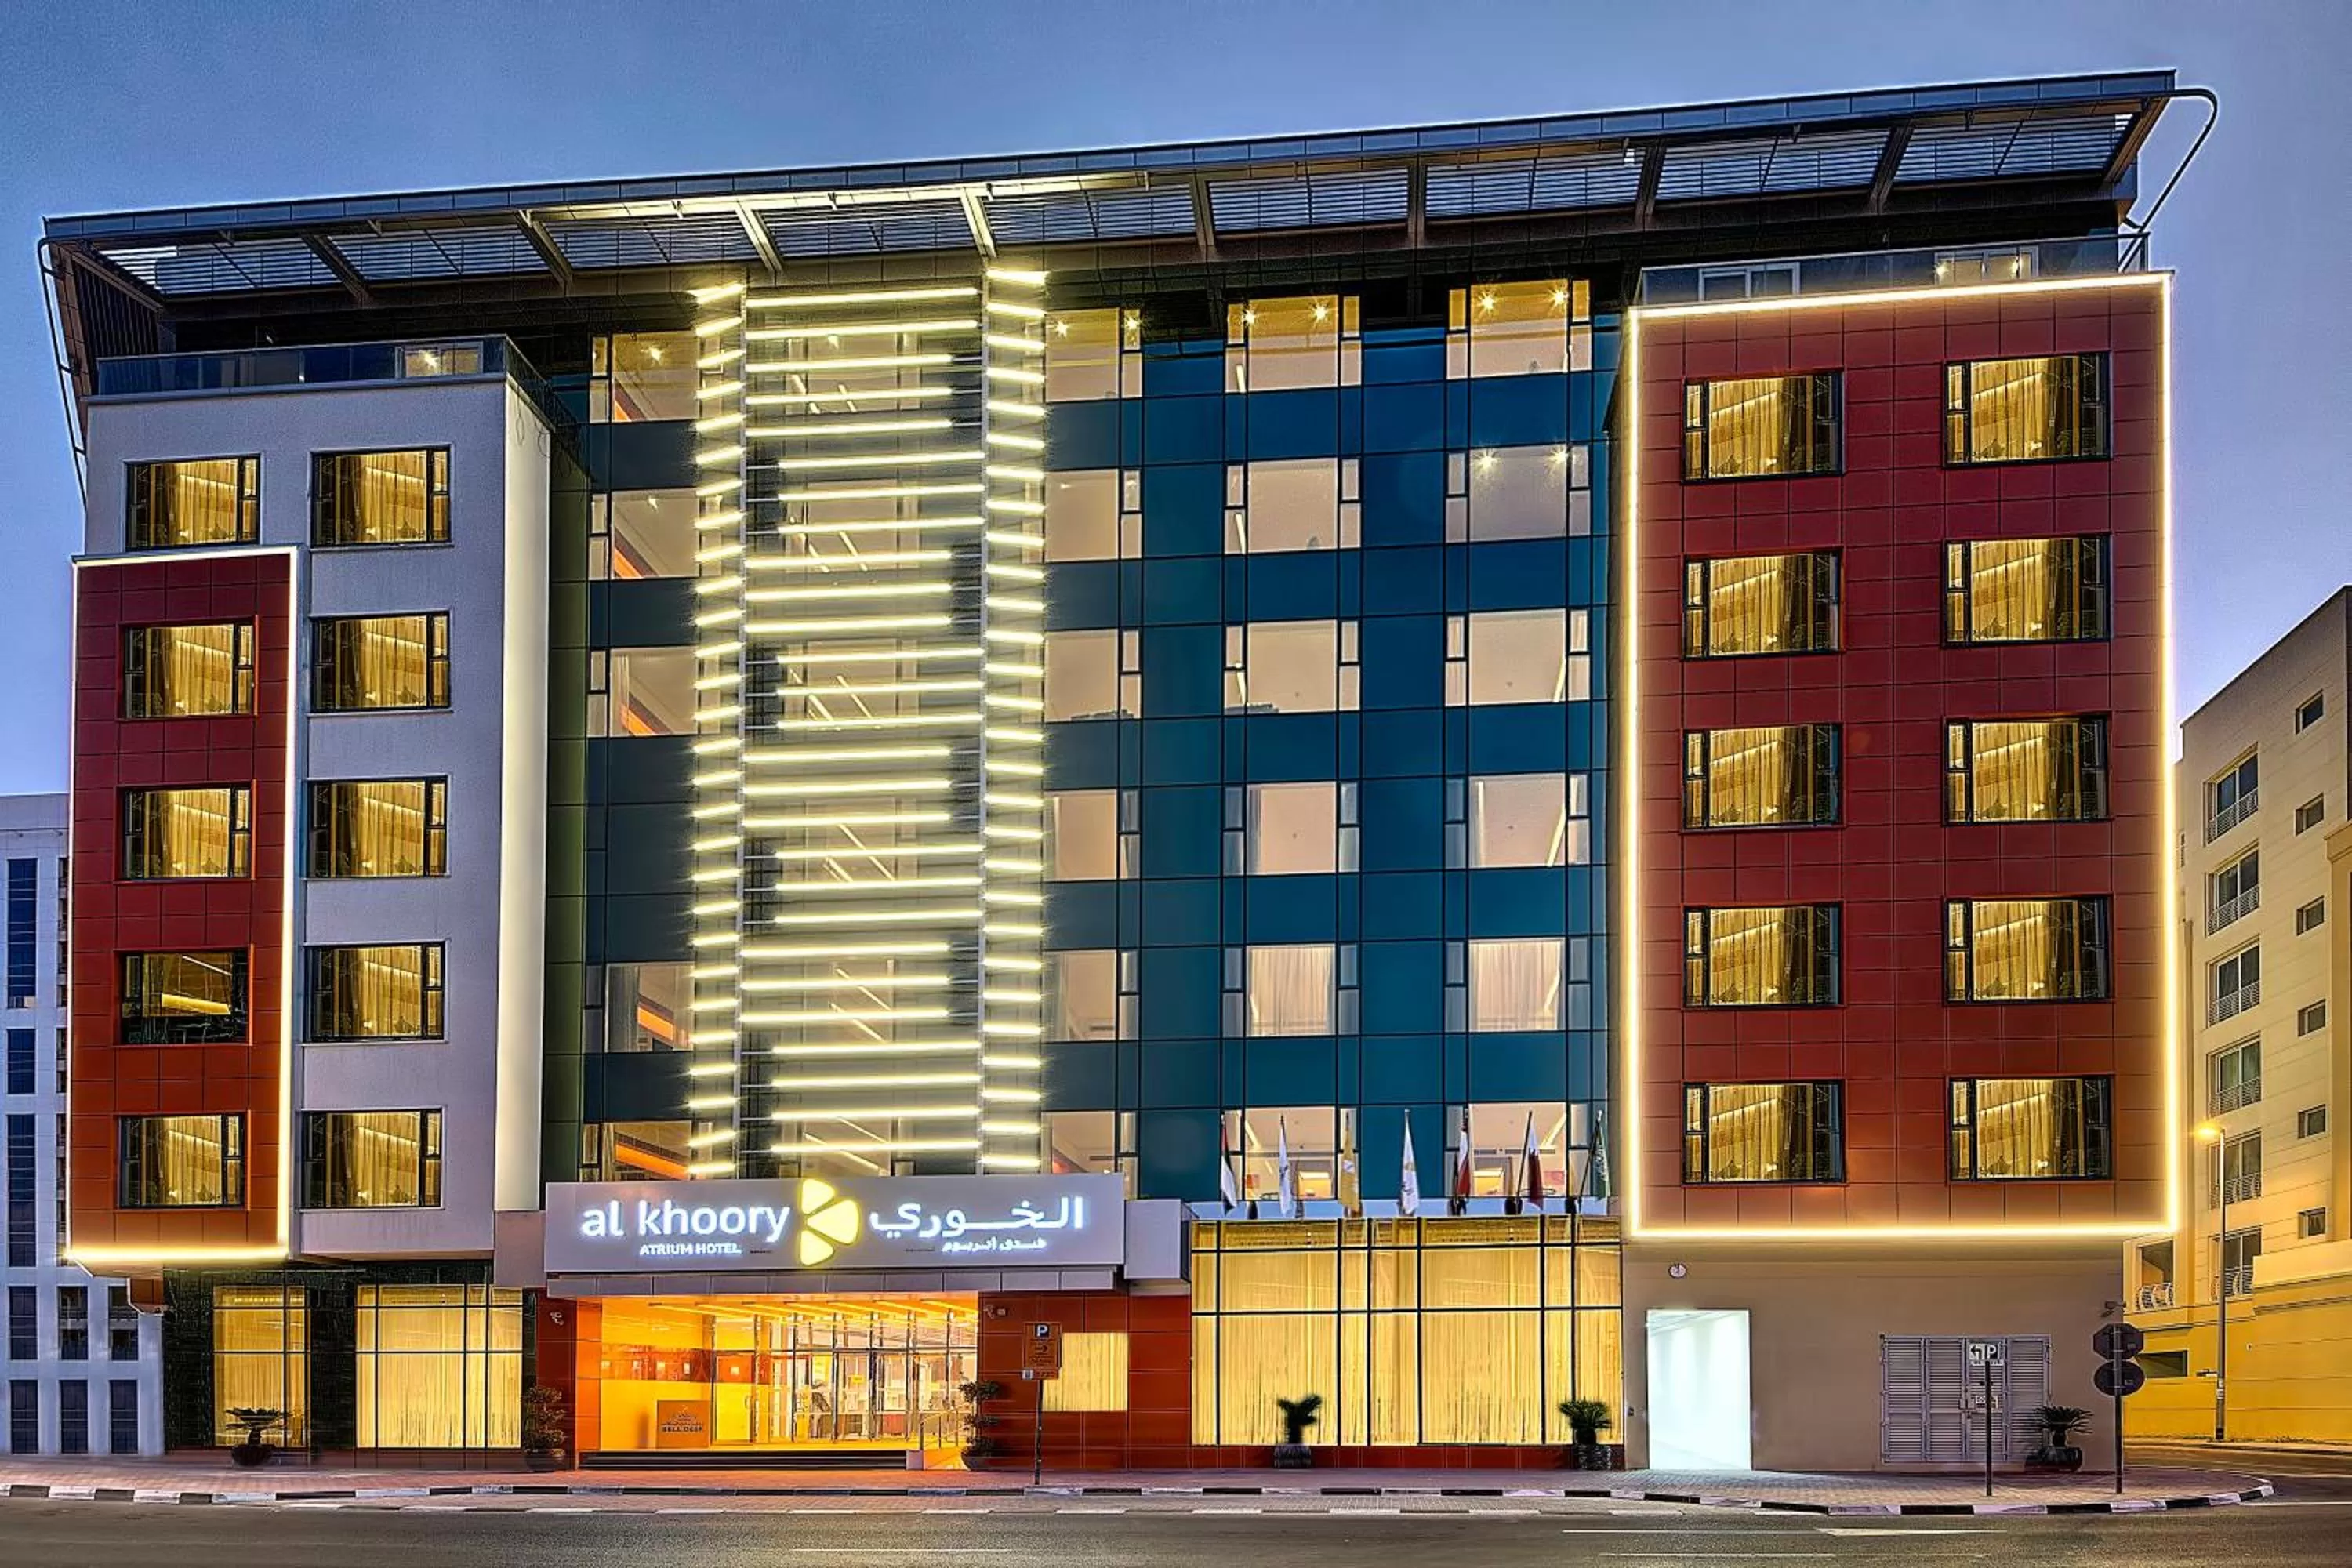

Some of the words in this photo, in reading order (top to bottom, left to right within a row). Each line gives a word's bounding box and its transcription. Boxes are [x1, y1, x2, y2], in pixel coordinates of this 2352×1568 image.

[581, 1200, 625, 1236] al
[638, 1199, 790, 1243] khoory
[869, 1196, 1083, 1238] الخوري
[639, 1243, 693, 1255] ATRIUM
[695, 1242, 742, 1254] HOTEL
[1036, 1324, 1048, 1337] P
[1987, 1345, 1997, 1359] P
